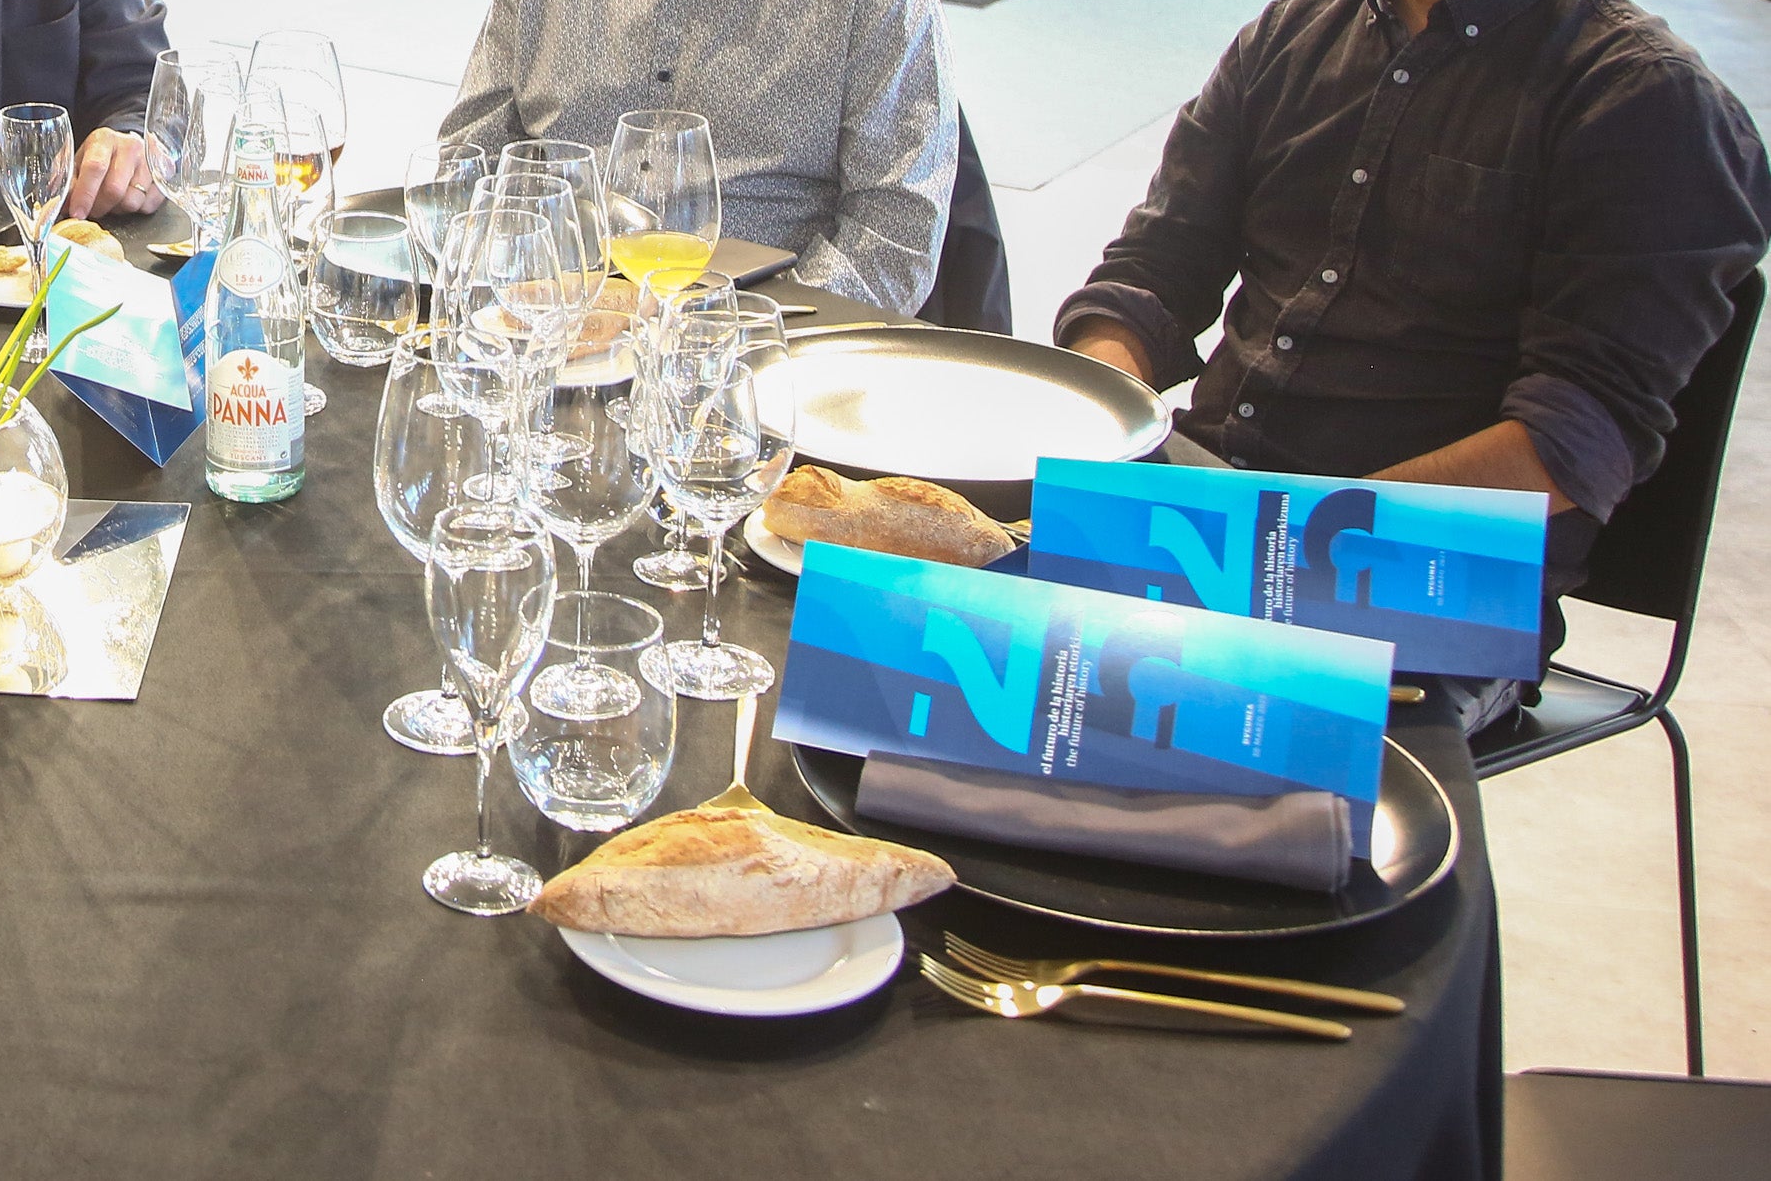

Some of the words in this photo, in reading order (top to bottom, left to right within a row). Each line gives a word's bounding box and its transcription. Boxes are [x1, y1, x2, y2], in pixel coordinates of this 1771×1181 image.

[238, 167, 268, 181] PANNA
[235, 274, 263, 283] 1564
[231, 383, 267, 398] ACQUA
[214, 392, 287, 427] PANNA
[1277, 494, 1290, 550] etorkizuna
[1264, 531, 1277, 572] historia
[1285, 537, 1299, 572] history
[1263, 583, 1273, 596] de
[1264, 573, 1274, 583] la
[1273, 551, 1286, 609] historiaren
[1285, 572, 1294, 584] of
[1283, 586, 1293, 616] future
[1051, 650, 1069, 695] historia
[1075, 659, 1093, 697] history
[1050, 695, 1062, 707] la
[1058, 671, 1077, 737] historiaren
[1074, 697, 1085, 710] of
[1047, 707, 1060, 724] de
[1068, 713, 1083, 748] future
[1042, 724, 1058, 762] futuro
[1040, 763, 1052, 775] el
[1066, 750, 1077, 768] the
